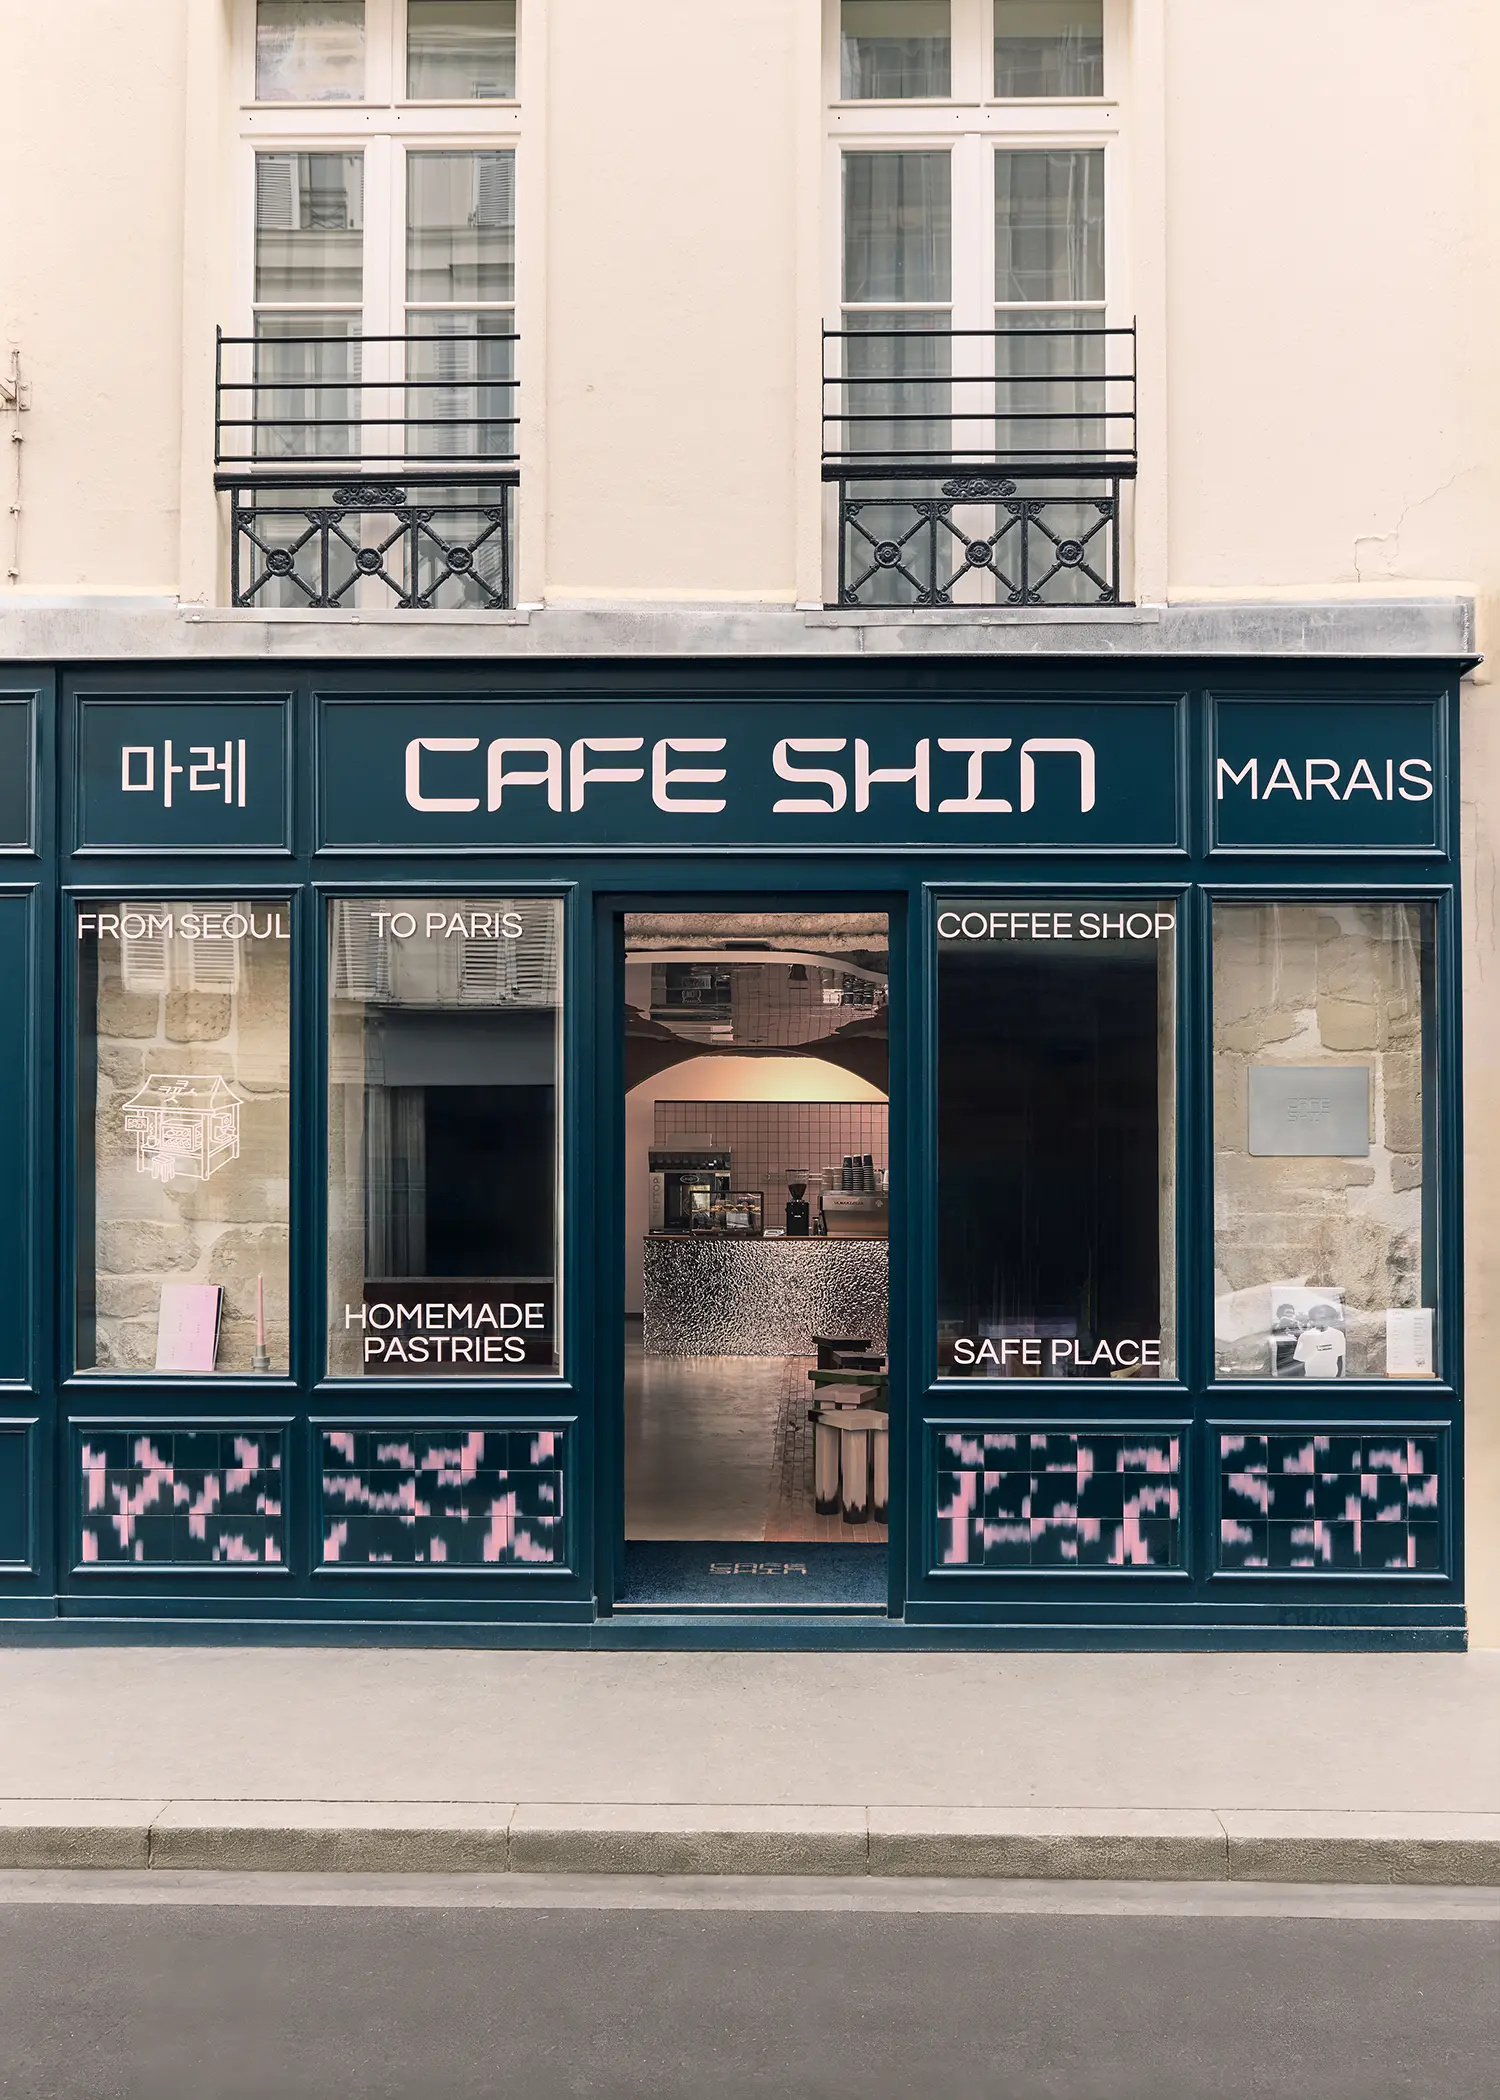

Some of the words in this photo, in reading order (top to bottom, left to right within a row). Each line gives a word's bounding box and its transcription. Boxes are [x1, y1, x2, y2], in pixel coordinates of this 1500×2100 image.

[122, 740, 245, 807] 마레
[405, 738, 726, 812] CAFE
[773, 738, 1095, 812] SHIN
[1217, 759, 1432, 801] MARAIS
[78, 913, 173, 939] FROM
[180, 913, 290, 939] SEOUL
[371, 912, 416, 938] TO
[427, 912, 523, 938] PARIS
[937, 912, 1072, 938] COFFEE
[1079, 912, 1175, 938] SHOP
[345, 1303, 545, 1329] HOMEMADE
[364, 1336, 526, 1362] PASTRIES
[954, 1338, 1042, 1365] SAFE
[1051, 1339, 1161, 1366] PLACE
